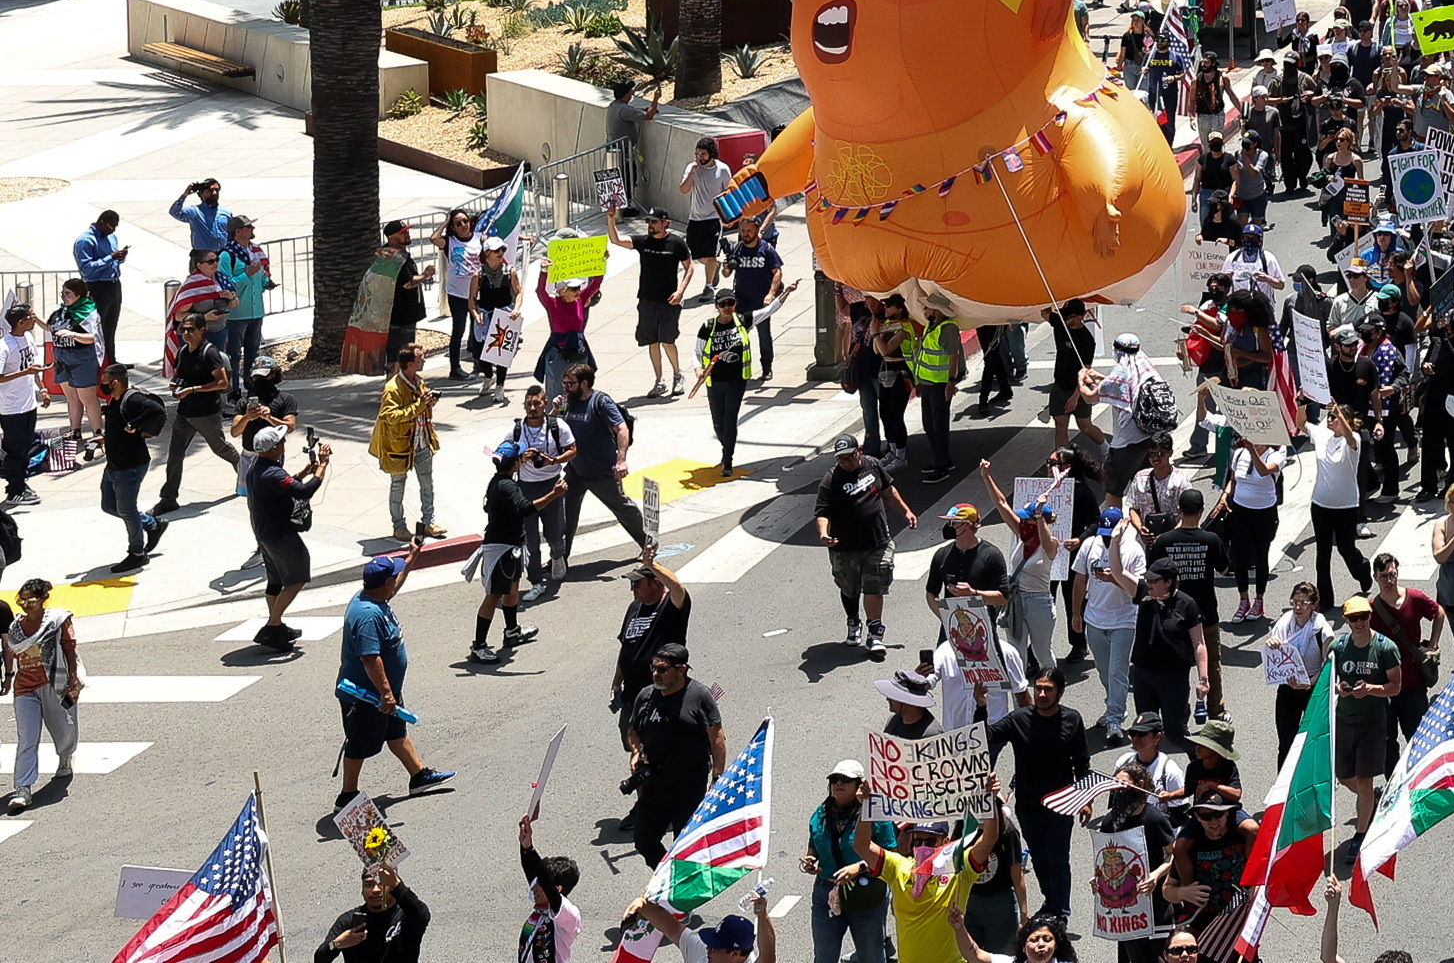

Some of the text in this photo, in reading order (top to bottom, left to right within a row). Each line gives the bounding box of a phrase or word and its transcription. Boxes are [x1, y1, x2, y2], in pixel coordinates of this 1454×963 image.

[1391, 154, 1438, 181] FIGHT FOR
[1419, 197, 1445, 220] MOTHER
[502, 330, 513, 350] NO
[841, 473, 877, 494] Dodgers
[1355, 660, 1379, 669] SIERRA
[1355, 668, 1372, 676] CLUB
[978, 668, 1004, 684] KINGS
[869, 726, 981, 762] NO KINGS
[871, 750, 989, 782] NO CROWNS
[871, 773, 988, 800] NO FASCIST
[1110, 912, 1149, 931] KINGS
